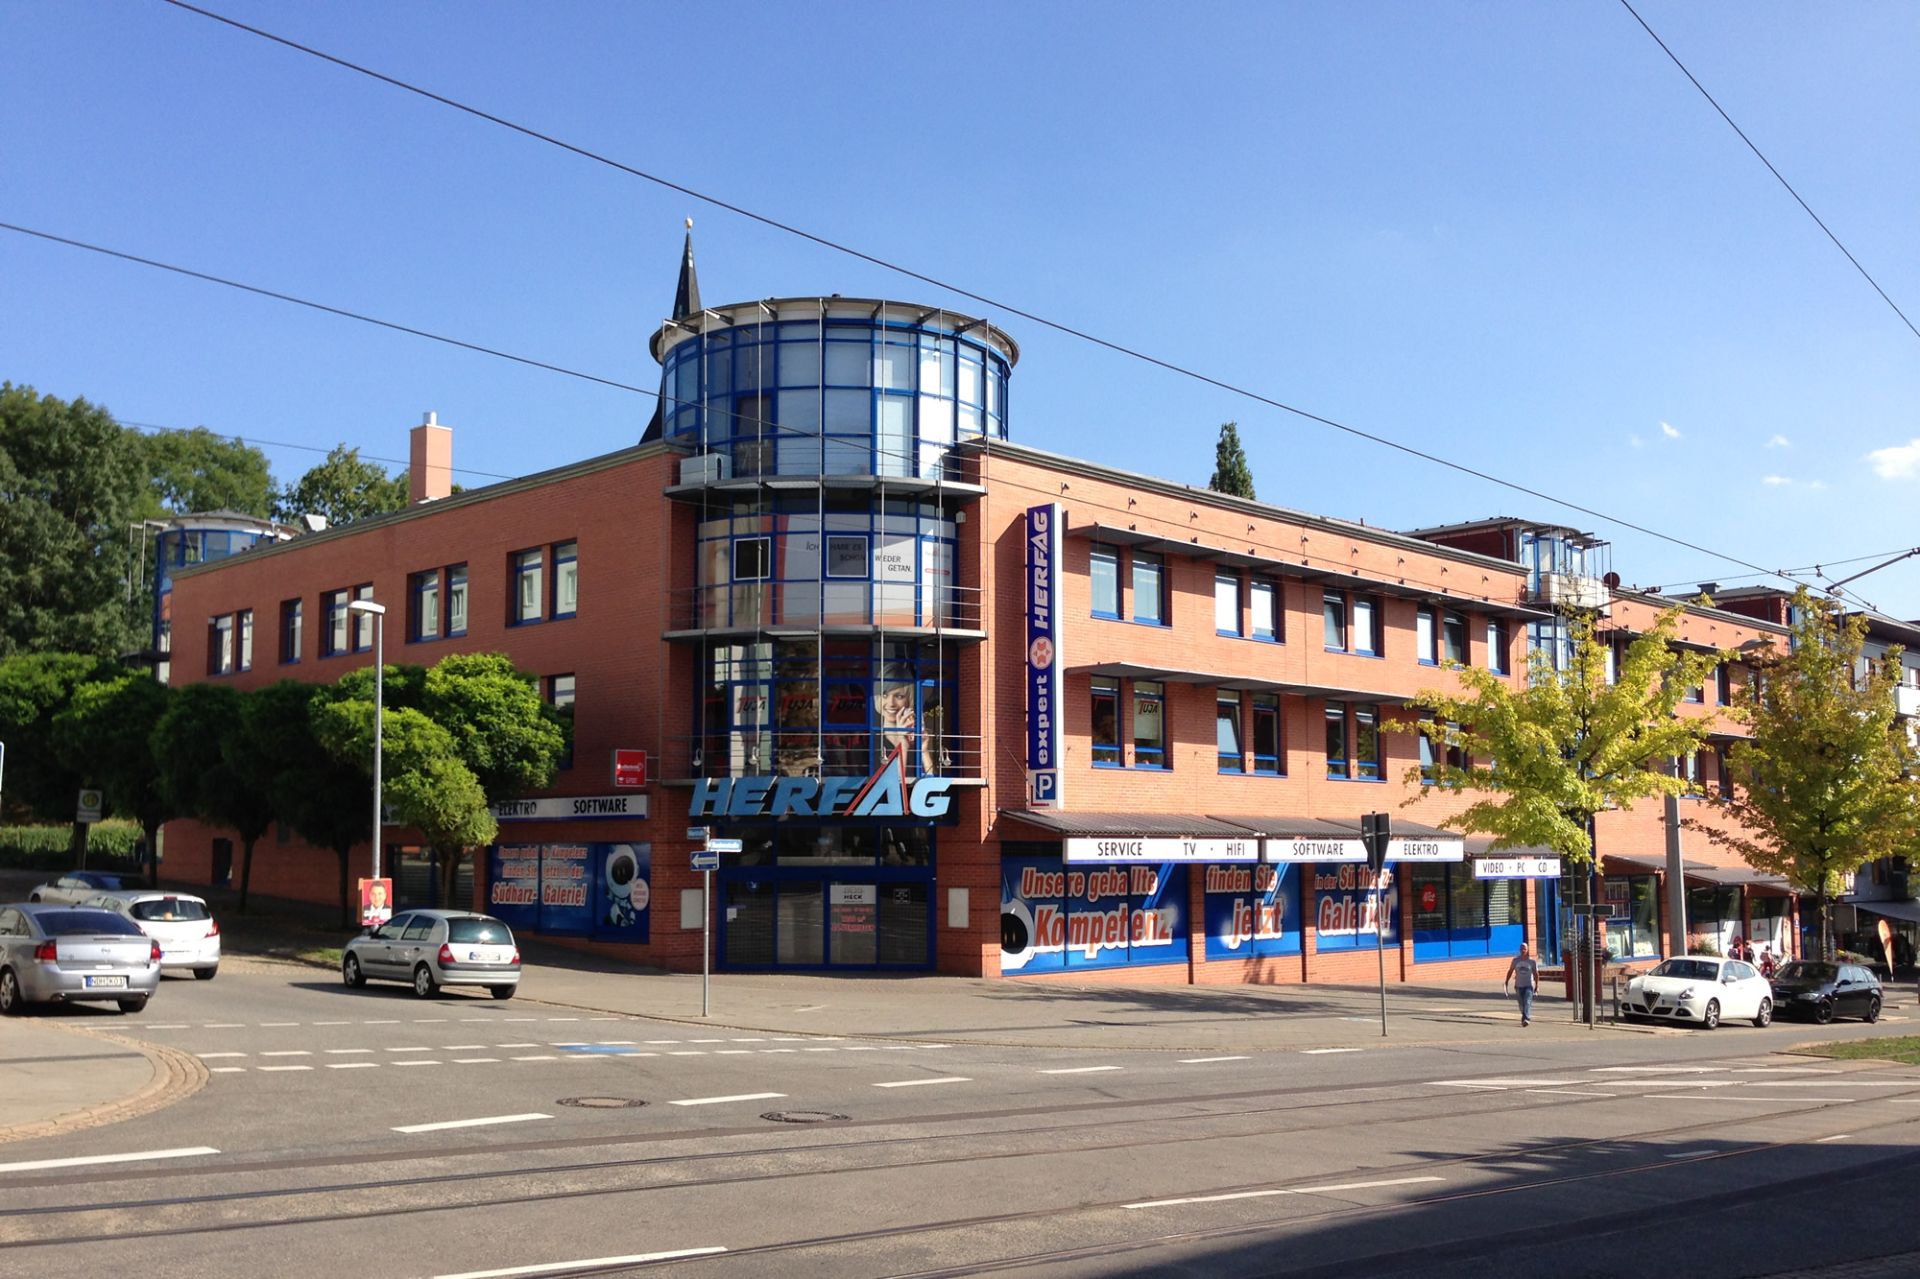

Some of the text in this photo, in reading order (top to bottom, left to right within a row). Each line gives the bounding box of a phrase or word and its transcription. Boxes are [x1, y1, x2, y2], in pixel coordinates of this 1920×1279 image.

[875, 555, 901, 563] WEDER
[888, 564, 912, 572] GETAN.
[1033, 511, 1049, 630] HERFAG
[1139, 700, 1159, 714] TUJA
[1036, 674, 1049, 765] expert
[688, 745, 953, 817] HERFAG
[1038, 774, 1053, 798] P
[499, 798, 627, 816] ELEKTRO SOFTWARE
[1097, 842, 1143, 856] SERVICE
[1183, 842, 1245, 856] TV HIFI
[1293, 843, 1344, 856] SOFTWARE
[1403, 843, 1439, 856] ELEKTRO
[1482, 862, 1548, 874] VIDEO PC CD
[1021, 866, 1158, 901] Unsere geballte
[1206, 865, 1278, 893] finden Sie
[1314, 873, 1323, 889] in
[1324, 873, 1338, 889] der
[492, 882, 588, 905] Südharz- Galerie!
[1230, 898, 1283, 947] jetzt
[1318, 894, 1391, 935] Galerie!
[1034, 903, 1172, 957] Kompetenz
